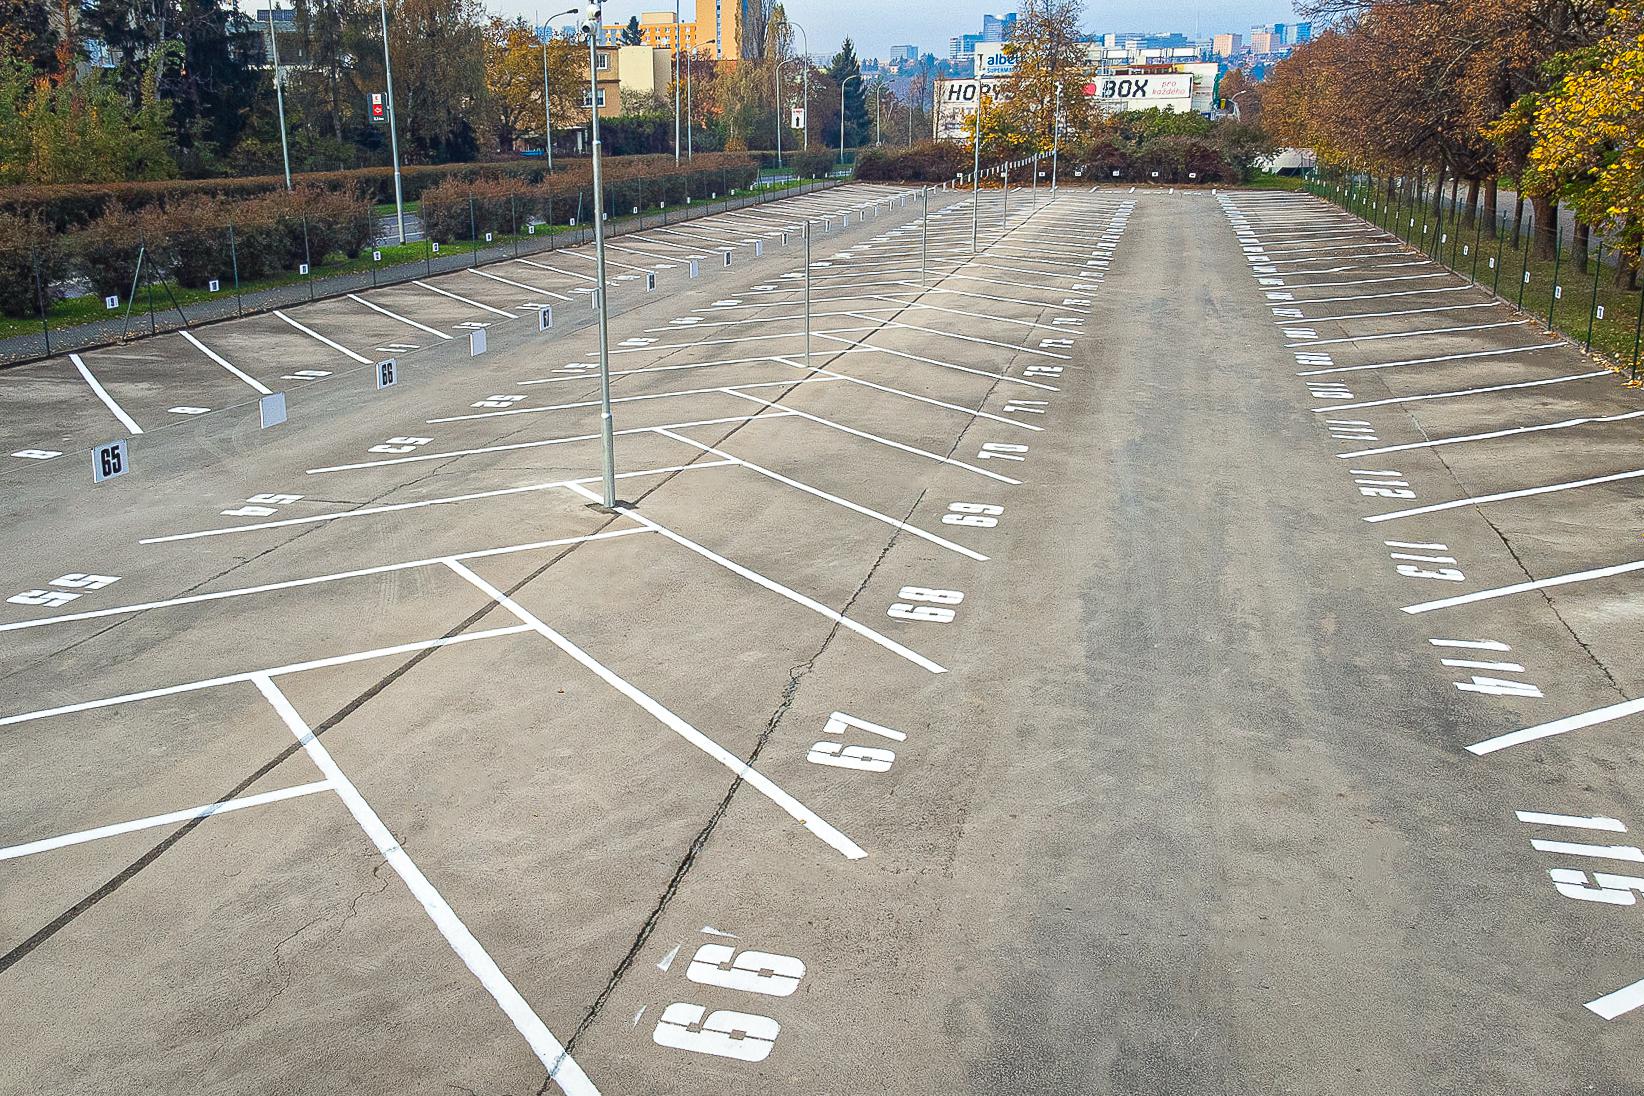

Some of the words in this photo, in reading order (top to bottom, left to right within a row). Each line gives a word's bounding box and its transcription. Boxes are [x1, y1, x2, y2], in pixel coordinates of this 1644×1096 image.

[1102, 79, 1149, 98] BOX
[543, 309, 551, 328] 67
[375, 343, 421, 353] 11
[280, 370, 333, 380] 10
[381, 362, 394, 386] 66
[551, 362, 601, 373] 51
[1022, 365, 1063, 378] 72
[470, 394, 529, 408] 52
[1305, 381, 1355, 399] 110
[1002, 400, 1049, 414] 71
[1325, 419, 1379, 440] 111
[367, 436, 435, 453] 53
[977, 442, 1029, 462] 70
[100, 444, 123, 478] 65
[1349, 469, 1417, 499] 112
[219, 493, 305, 517] 54
[941, 502, 1004, 528] 69
[1383, 540, 1466, 582] 113
[6, 573, 122, 607] 55
[887, 586, 965, 623] 68
[1428, 638, 1544, 698] 114
[805, 711, 907, 772] 67
[1515, 810, 1644, 906] 115
[653, 944, 806, 1062] 66
